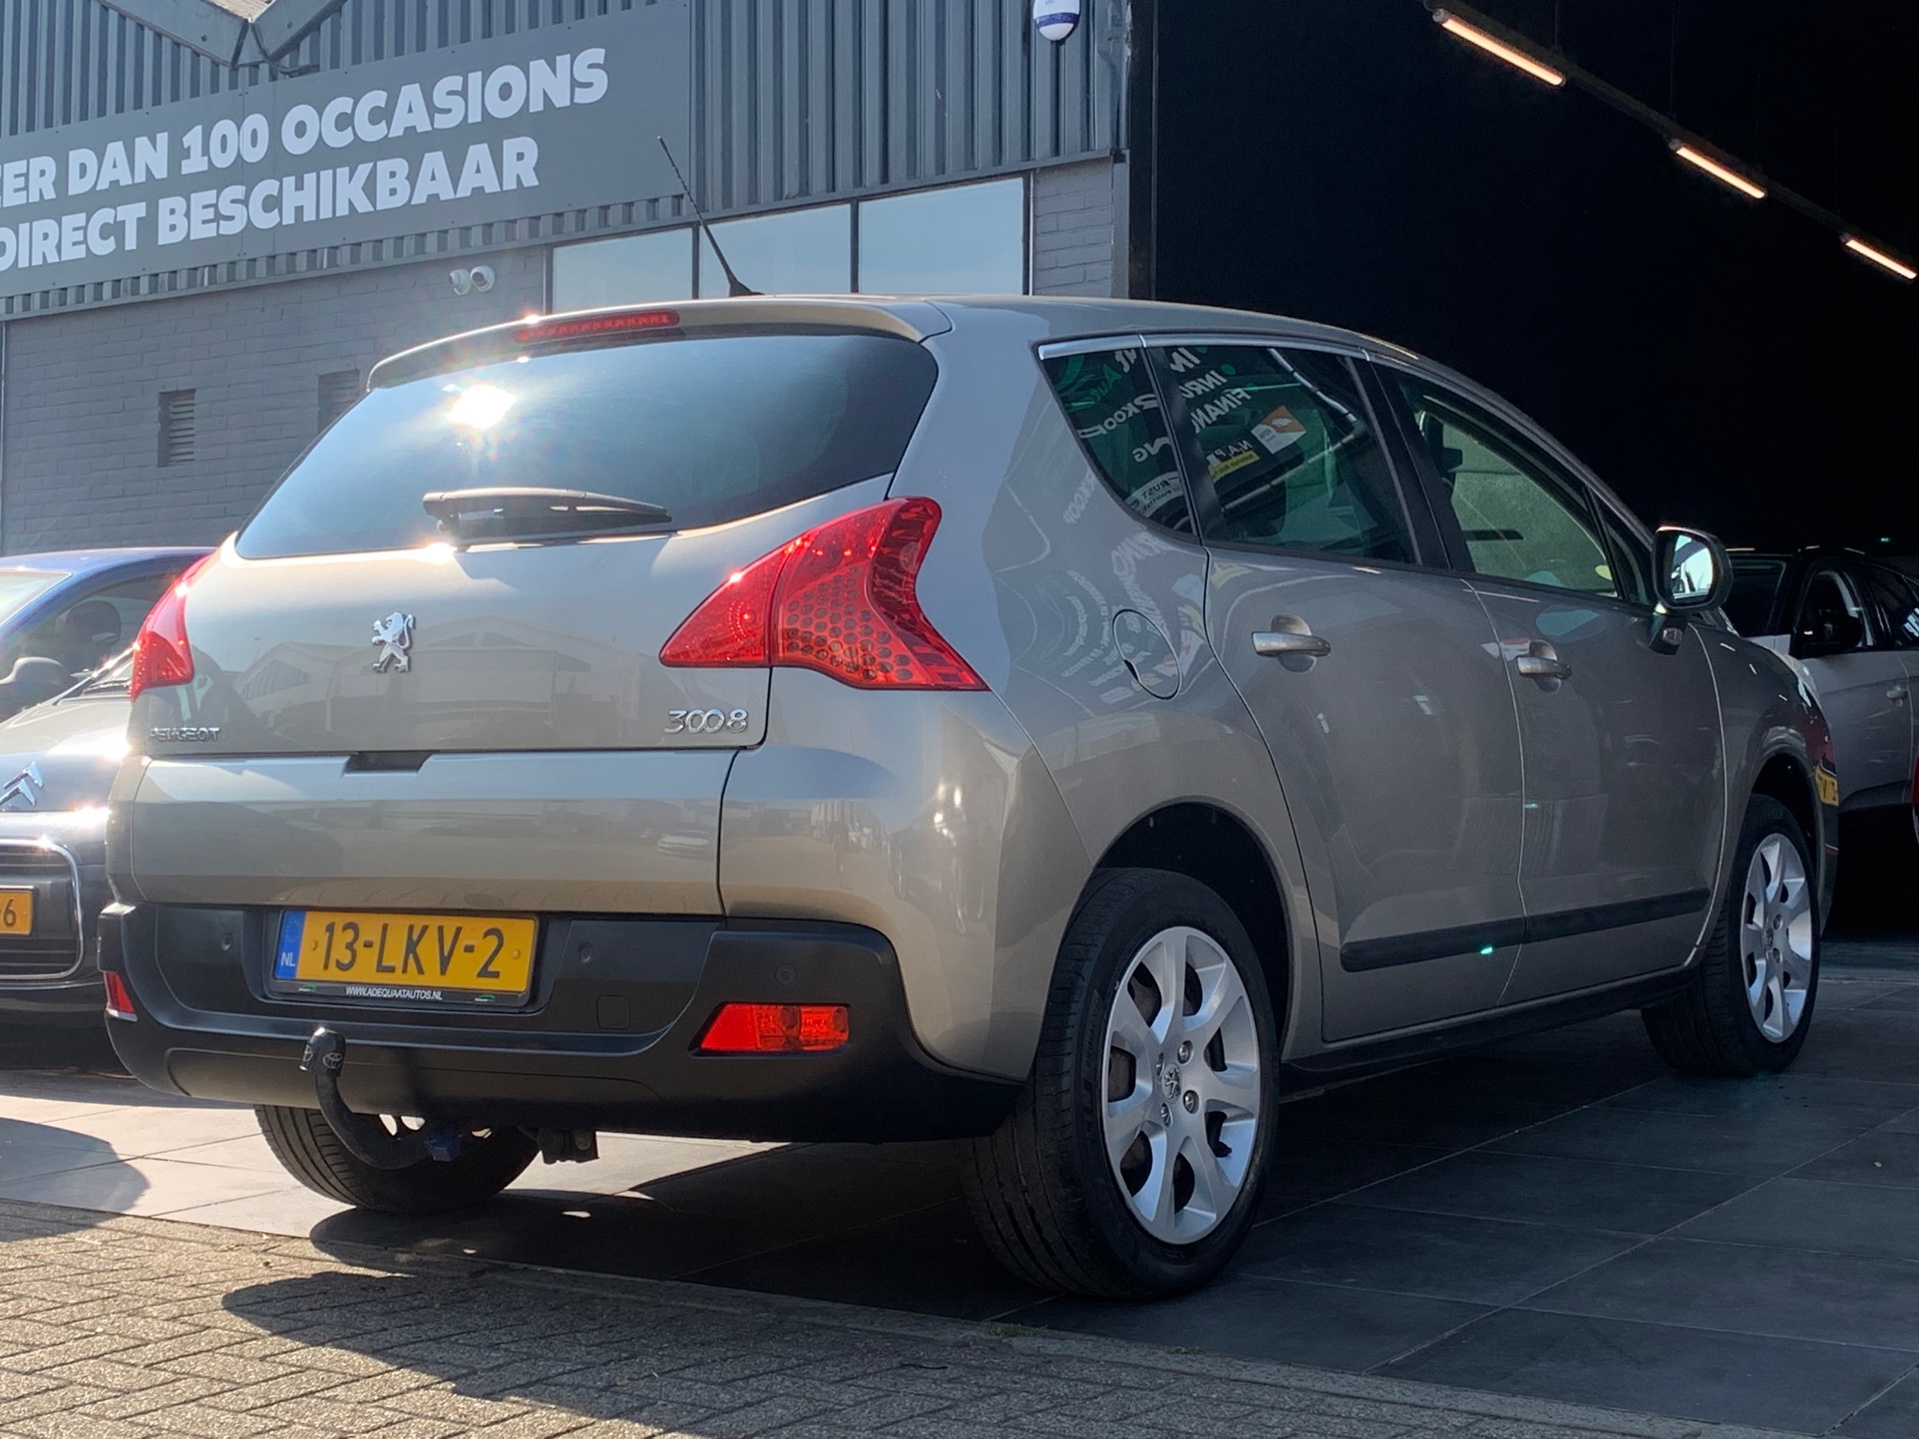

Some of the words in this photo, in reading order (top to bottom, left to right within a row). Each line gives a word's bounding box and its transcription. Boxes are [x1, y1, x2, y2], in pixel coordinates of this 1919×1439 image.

[0, 156, 57, 208] ER
[68, 132, 169, 196] DAN
[181, 113, 269, 175] 100
[281, 48, 608, 155] OCCASIONS
[0, 201, 147, 272] DIRECT
[157, 136, 539, 246] BESCHIKBAAR
[149, 726, 222, 741] PEUGEOT
[663, 708, 749, 734] 3008
[280, 950, 297, 968] NL
[322, 920, 505, 979] 13-LKV-2
[345, 985, 444, 1001] WWW.ADEQUAATAUTOS.NL
